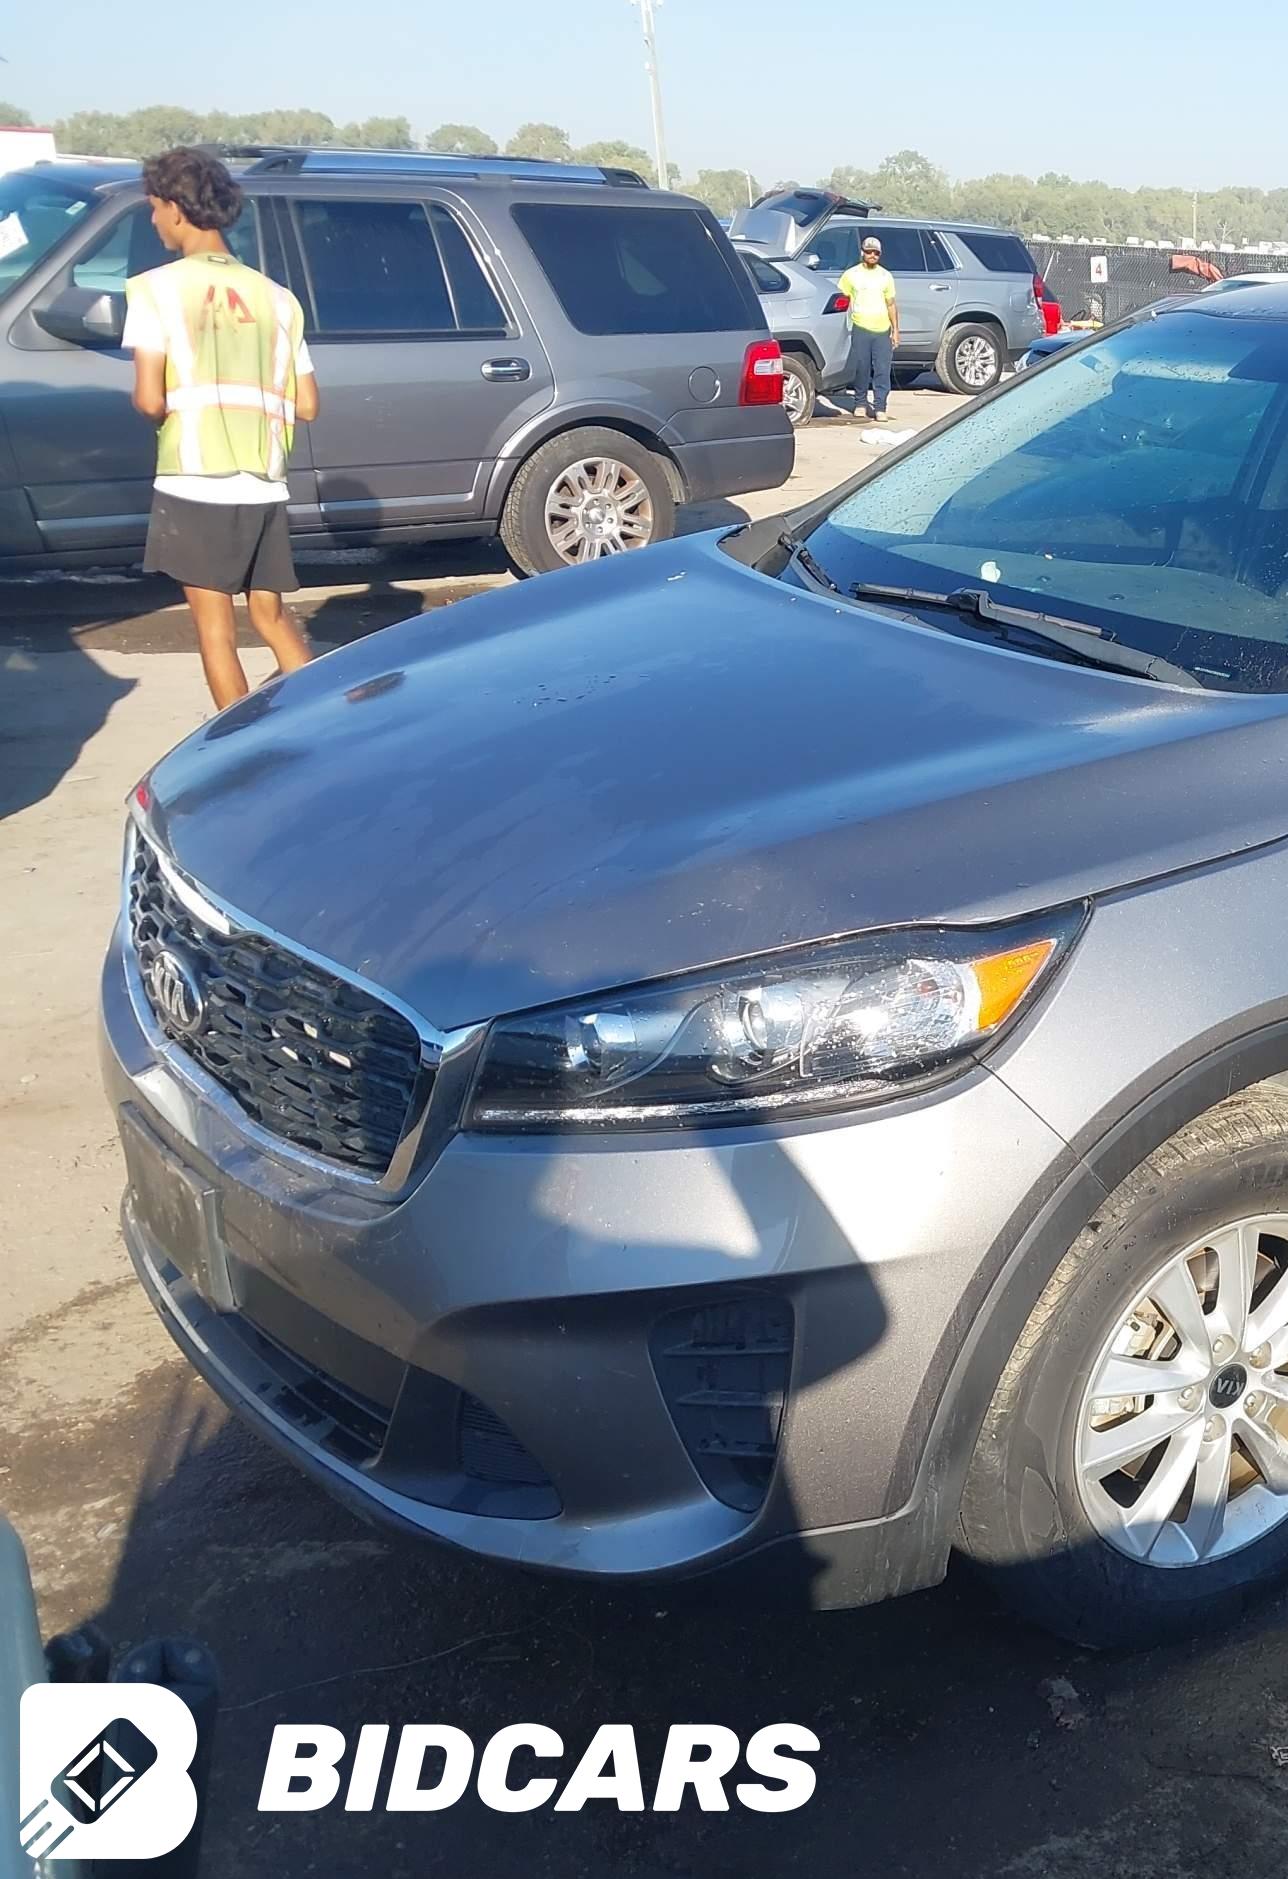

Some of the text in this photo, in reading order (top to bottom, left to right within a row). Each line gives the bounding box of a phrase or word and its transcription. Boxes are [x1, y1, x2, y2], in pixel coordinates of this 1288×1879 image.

[1095, 263, 1103, 276] 4
[150, 961, 190, 1023] KIA
[1217, 1378, 1245, 1396] KIA
